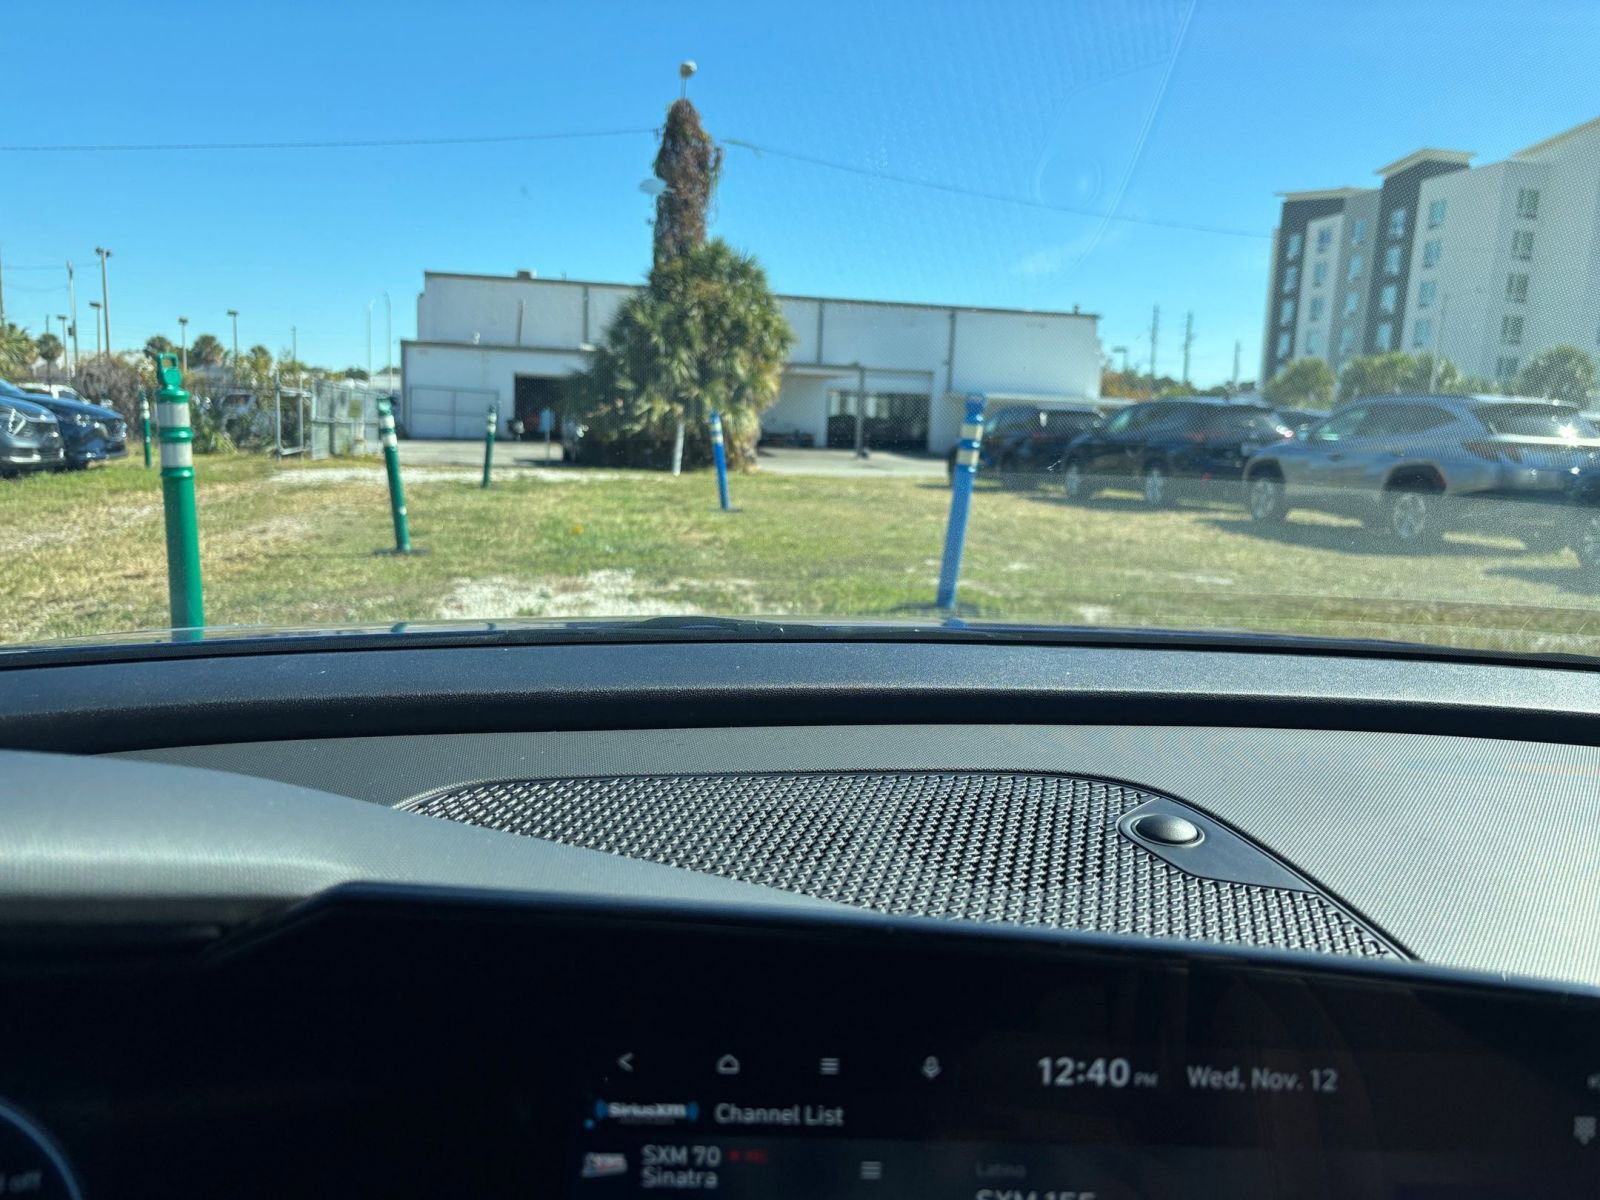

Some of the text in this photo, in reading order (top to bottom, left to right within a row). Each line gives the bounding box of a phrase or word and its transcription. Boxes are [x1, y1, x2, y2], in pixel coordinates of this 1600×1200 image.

[1038, 1056, 1159, 1088] 12:40 PM
[1251, 1067, 1304, 1091] Nov.
[1309, 1068, 1339, 1092] 12
[714, 1102, 845, 1126] Channel List
[641, 1144, 688, 1166] SXM
[691, 1144, 722, 1168] 70
[641, 1166, 719, 1189] Sinatra
